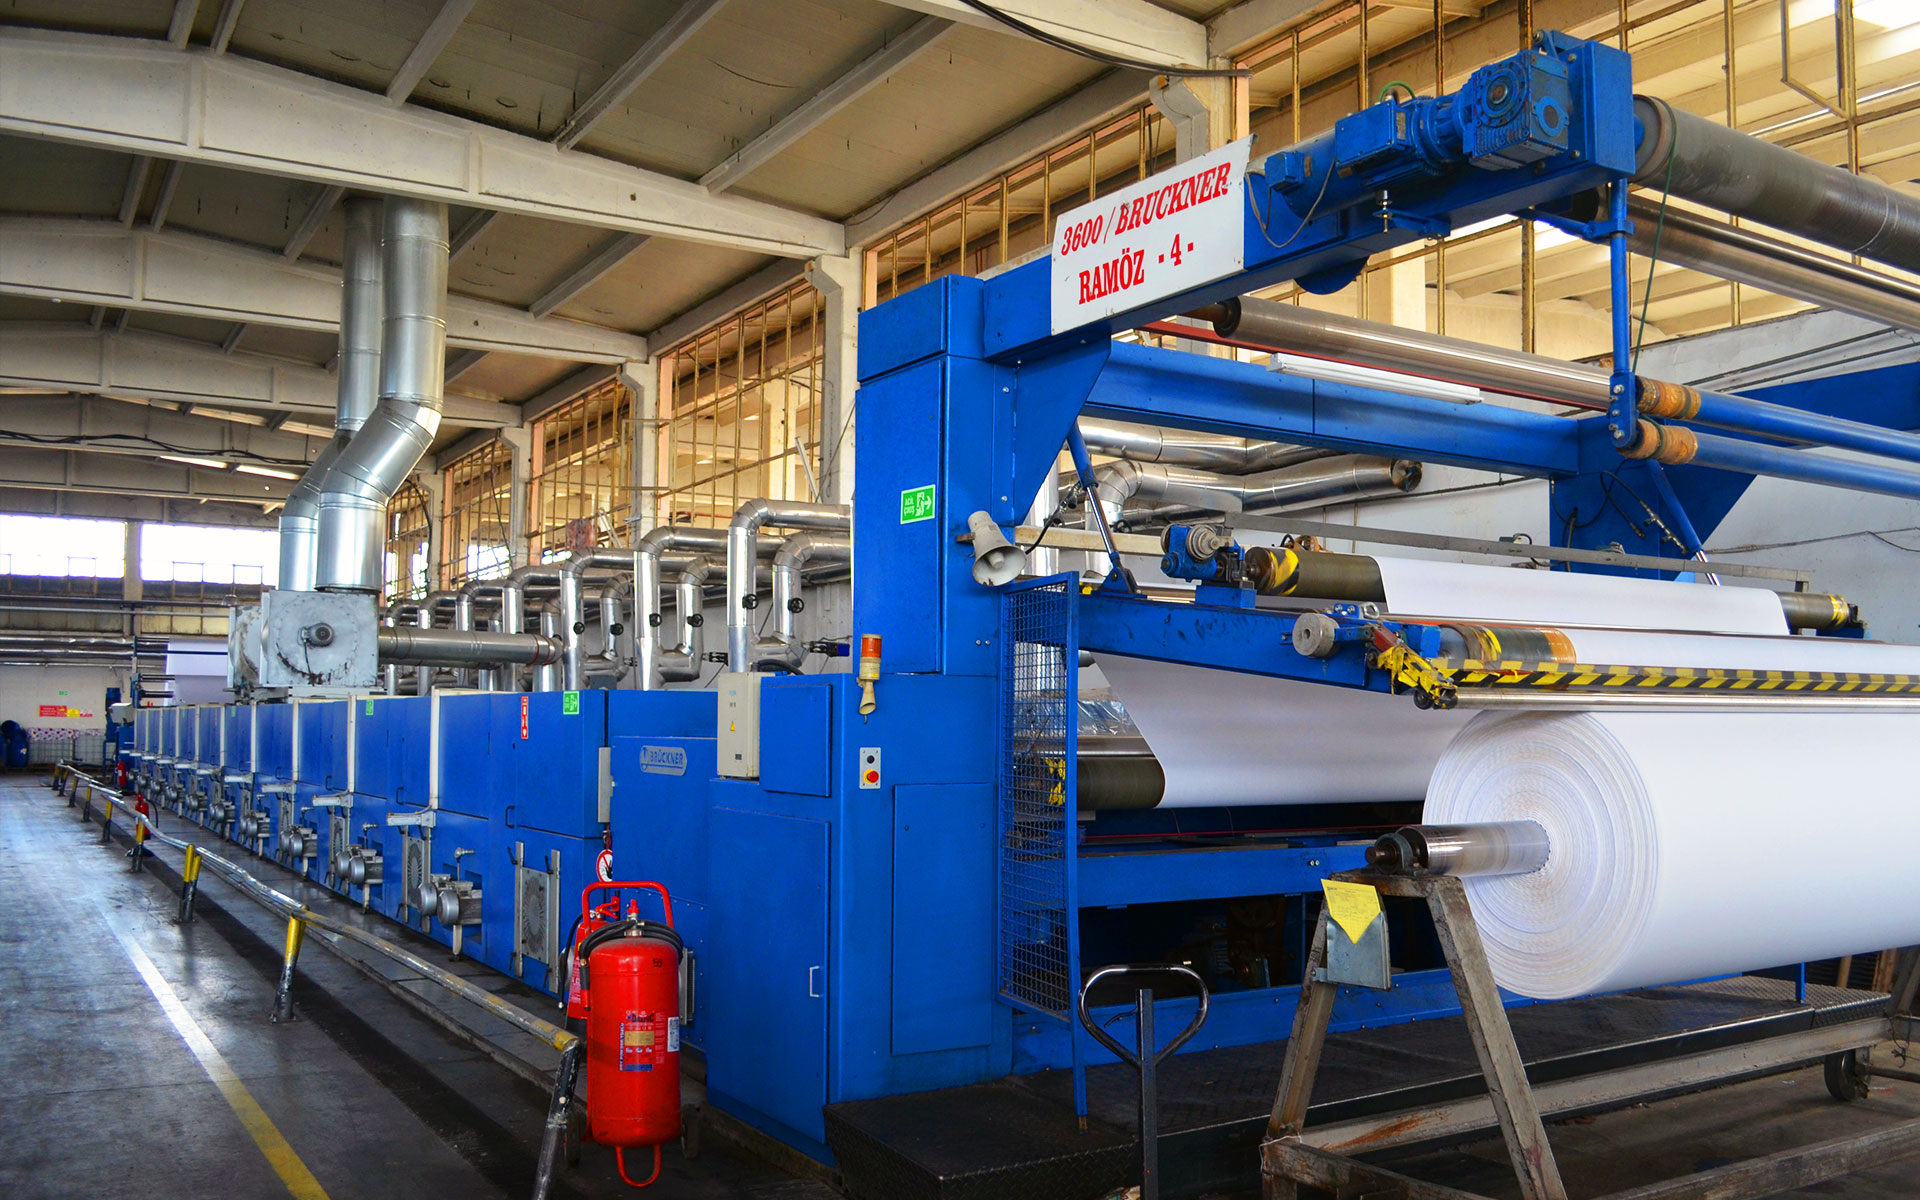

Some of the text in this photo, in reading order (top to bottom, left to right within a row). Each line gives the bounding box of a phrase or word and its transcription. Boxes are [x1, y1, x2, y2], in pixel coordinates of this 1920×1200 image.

[1061, 215, 1103, 256] 3600
[1114, 162, 1232, 235] BRUCKNER
[1078, 247, 1145, 305] RAMÖZ
